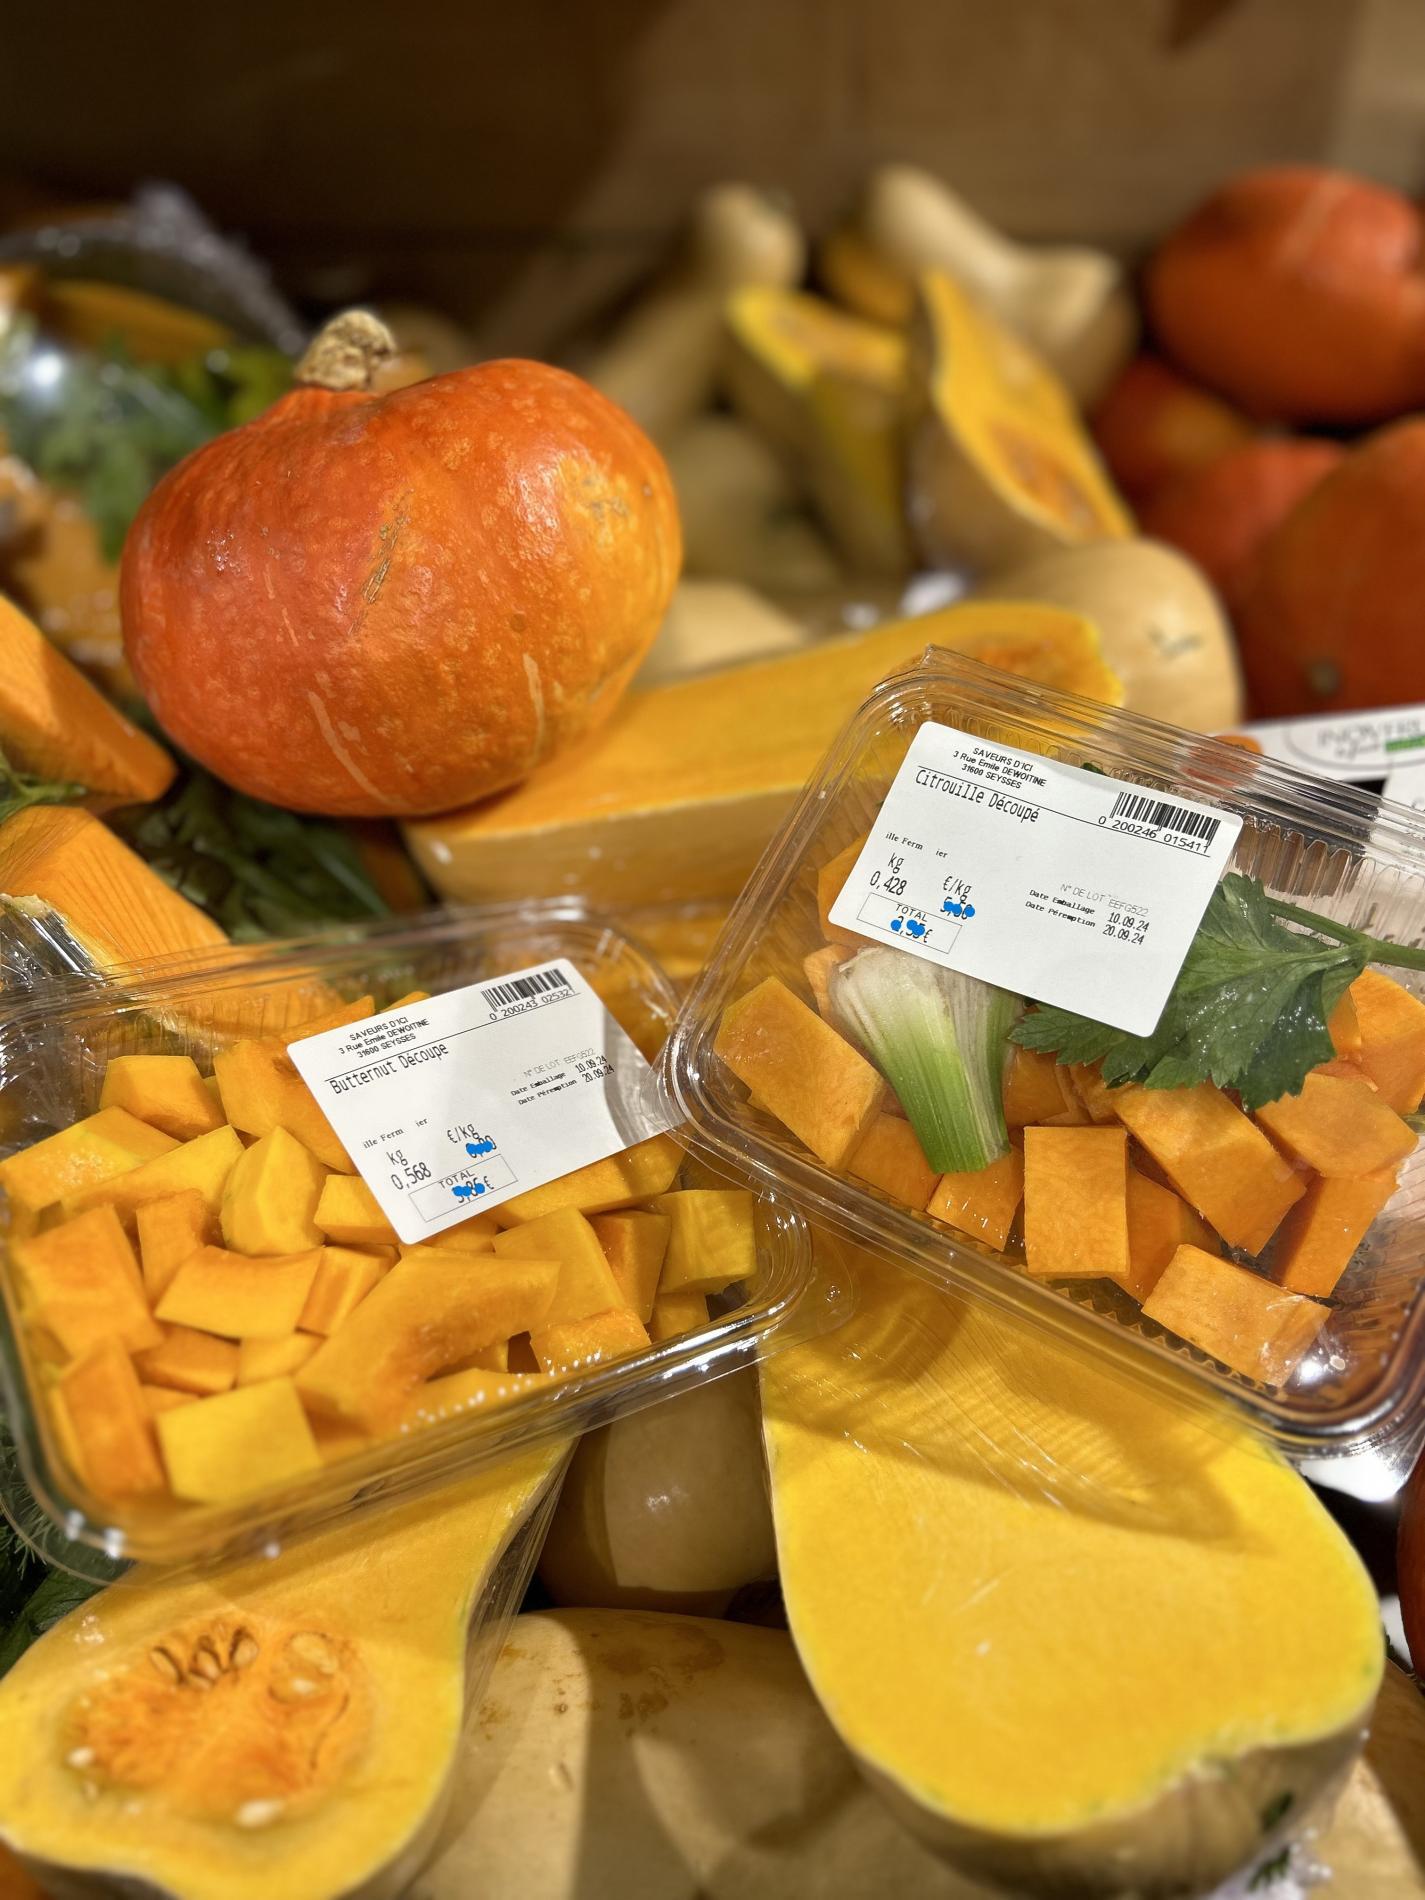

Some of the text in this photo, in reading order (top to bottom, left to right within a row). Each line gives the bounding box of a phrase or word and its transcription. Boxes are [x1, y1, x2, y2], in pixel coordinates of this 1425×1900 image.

[953, 750, 1047, 787] 3 Rue Emile DEWOITINE
[973, 748, 1033, 772] SAVEURS D'ICI
[962, 764, 1022, 789] 31600 SEYSSES
[916, 769, 1040, 823] Citrouille Découpé
[1098, 816, 1210, 853] 0 200246 015411
[902, 838, 924, 850] Ferm
[936, 849, 948, 858] ier
[888, 852, 904, 874] kg
[870, 870, 908, 896] 0,428
[943, 876, 972, 902] €/kg
[1072, 887, 1086, 897] DE
[1086, 891, 1104, 902] LOT
[896, 904, 928, 922] TOTAL
[1025, 901, 1144, 946] Date Péremption 20.09.24
[1029, 890, 1150, 933] Date Emballage 10.09.24
[490, 1012, 498, 1021] 0
[501, 999, 538, 1017] 200243
[346, 1042, 363, 1052] Rue
[364, 1034, 386, 1046] Emile
[387, 1018, 430, 1038] DEWOITINE
[350, 1024, 388, 1041] SAVEURS
[357, 1033, 416, 1058] 31600 SEYSSES
[329, 1060, 397, 1094] Butternut
[511, 1055, 608, 1096] Date Emballage 10.09.24
[534, 1064, 546, 1074] DE
[546, 1059, 561, 1070] LOT
[518, 1064, 615, 1105] Date Péremption 20.09.24
[380, 1128, 405, 1142] Ferm
[416, 1118, 428, 1127] ier
[447, 1124, 480, 1144] €/kg
[386, 1149, 408, 1166] kg
[390, 1162, 432, 1190] 0,568
[438, 1170, 475, 1190] TOTAL
